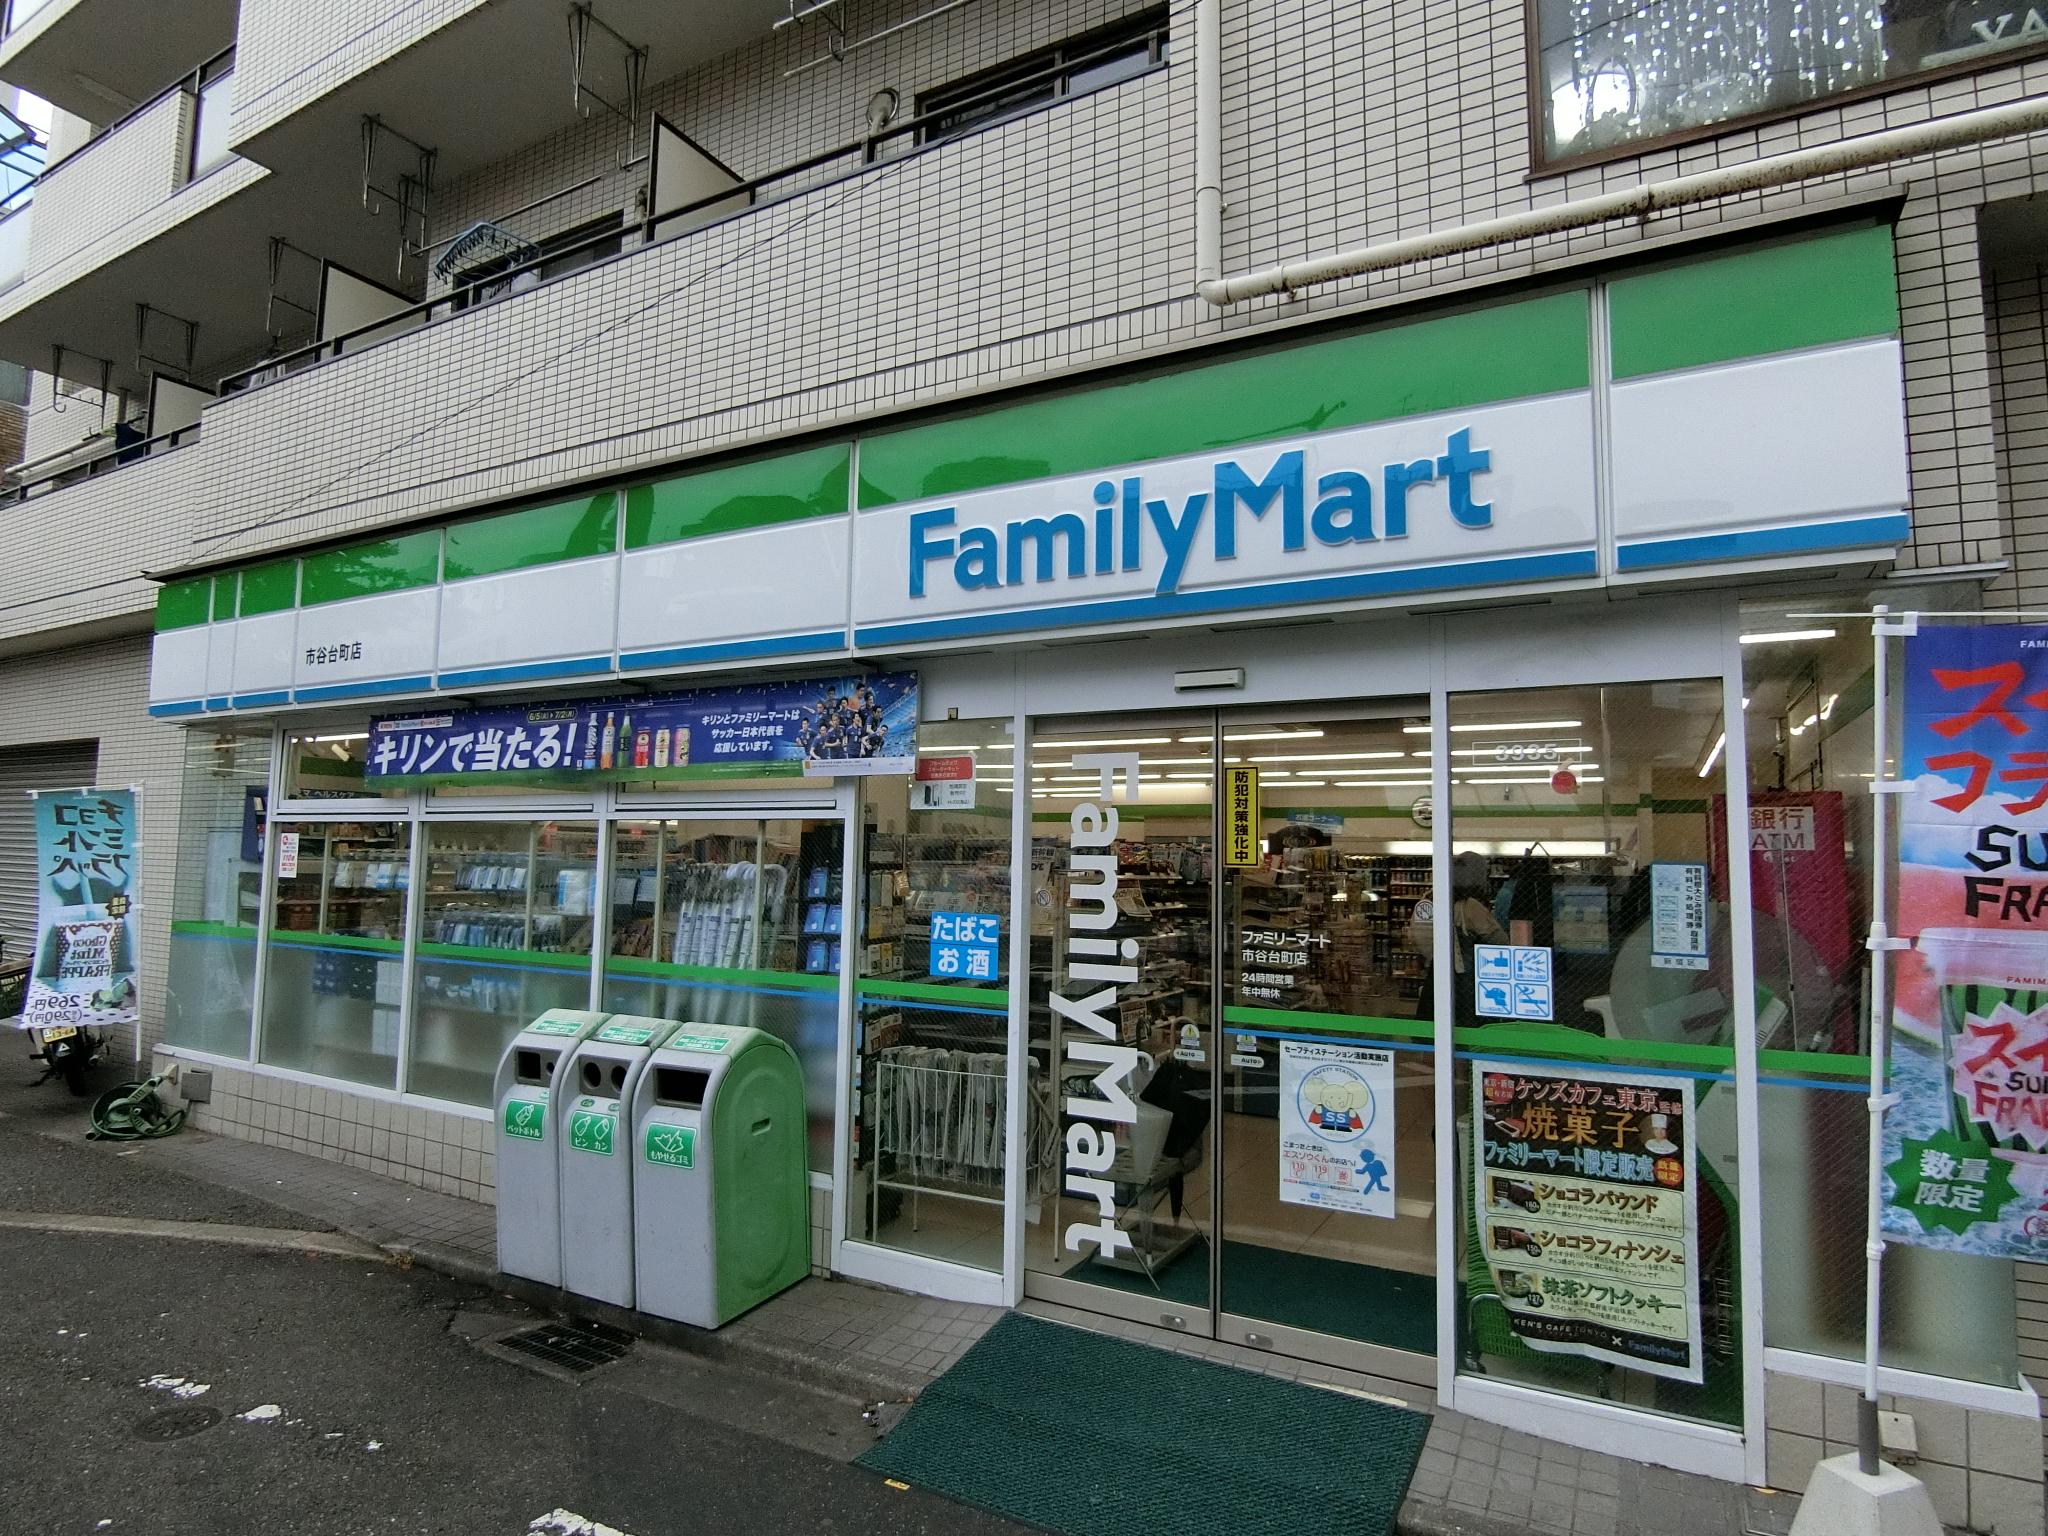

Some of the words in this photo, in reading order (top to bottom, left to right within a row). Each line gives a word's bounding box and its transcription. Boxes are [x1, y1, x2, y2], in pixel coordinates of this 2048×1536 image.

[909, 426, 1493, 598] FamilyMart
[306, 641, 362, 666] 市谷台町店
[702, 710, 800, 726] キリンとファミリーマートは
[712, 725, 783, 739] サッカー日本代表を
[374, 722, 578, 775] キリンで当たる!
[714, 740, 774, 754] 応援しています。
[1495, 744, 1557, 761] 3935
[1234, 771, 1249, 862] 防犯対策強化中
[1751, 808, 1804, 830] 銀行
[1752, 833, 1804, 849] ATM
[932, 915, 998, 943] たばこ
[1241, 931, 1332, 949] ファミリーマート
[937, 948, 991, 977] お酒
[1241, 949, 1308, 965] 市谷台町店
[1241, 972, 1294, 987] 24時間営業
[1241, 986, 1281, 999] 年中無休
[1049, 752, 1140, 1258] FamilyMart
[1325, 1111, 1346, 1123] SS
[1521, 1102, 1640, 1149] 焼菓子
[507, 1125, 540, 1137] ペットボトル
[651, 1150, 689, 1165] もやせるゴミ
[1483, 1140, 1655, 1182] ファミリーマート限定販売
[1920, 1149, 1990, 1183] 数量
[1540, 1183, 1660, 1213] ショコラパウンド
[1914, 1181, 1985, 1212] 限定
[1540, 1230, 1686, 1264] ショコラフィナンシェ
[1542, 1276, 1683, 1314] 抹茶ソフトクッキー
[1514, 1318, 1543, 1330] KEN'S
